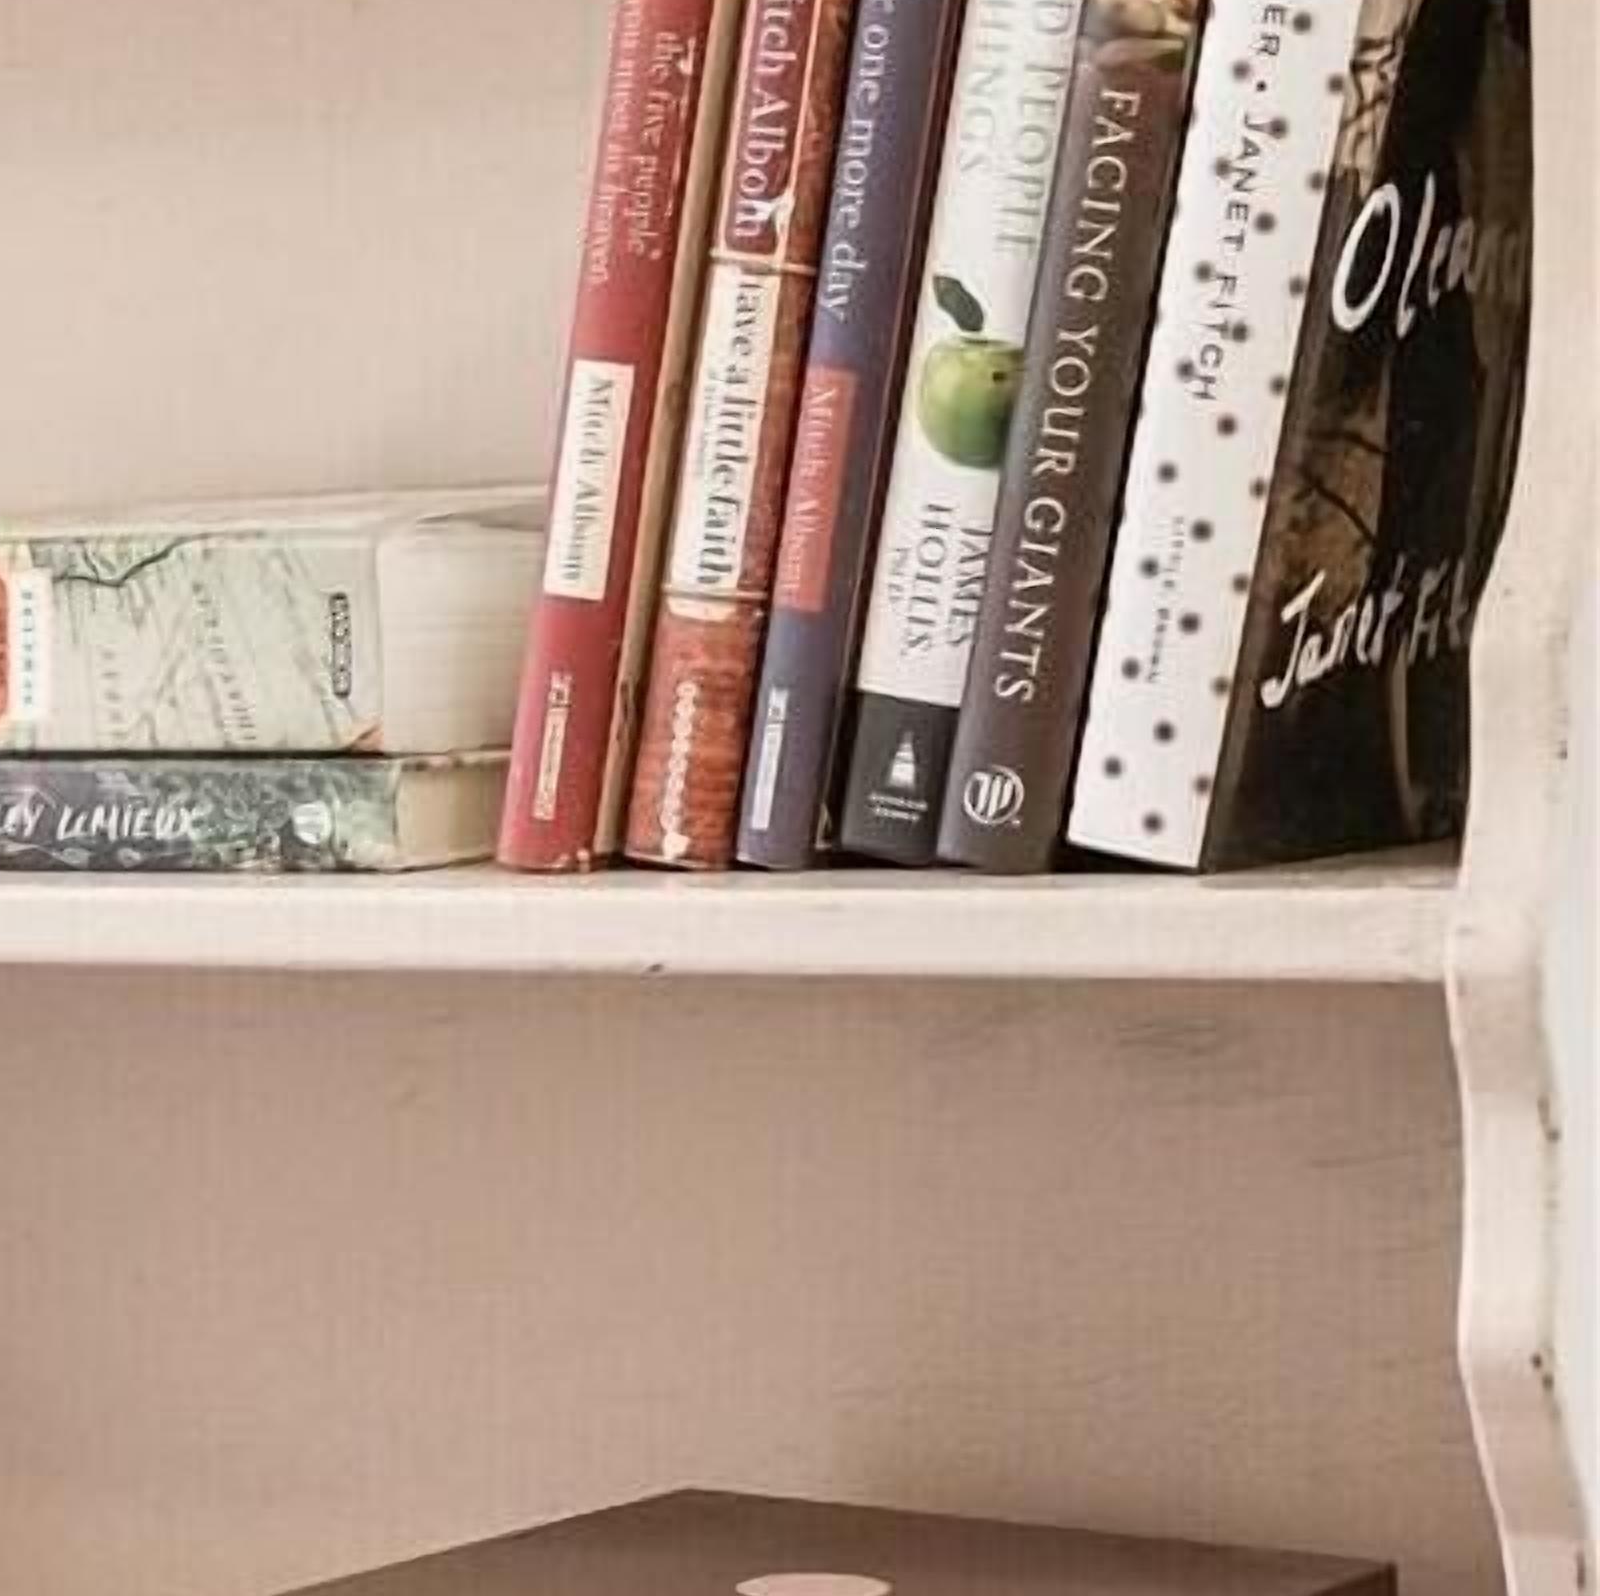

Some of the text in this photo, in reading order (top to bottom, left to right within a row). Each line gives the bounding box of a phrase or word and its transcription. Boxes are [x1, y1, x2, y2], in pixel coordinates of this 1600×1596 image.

[856, 24, 892, 105] one
[733, 90, 791, 238] Albom
[838, 118, 876, 230] more
[994, 62, 1068, 259] PEOPLE
[1212, 110, 1274, 267] JANET
[822, 237, 869, 325] day
[1187, 276, 1238, 402] FITCH
[711, 394, 759, 486] little
[993, 88, 1141, 703] FACING YOUR GIANTS
[695, 490, 742, 588] faith
[1260, 553, 1404, 709] Janet
